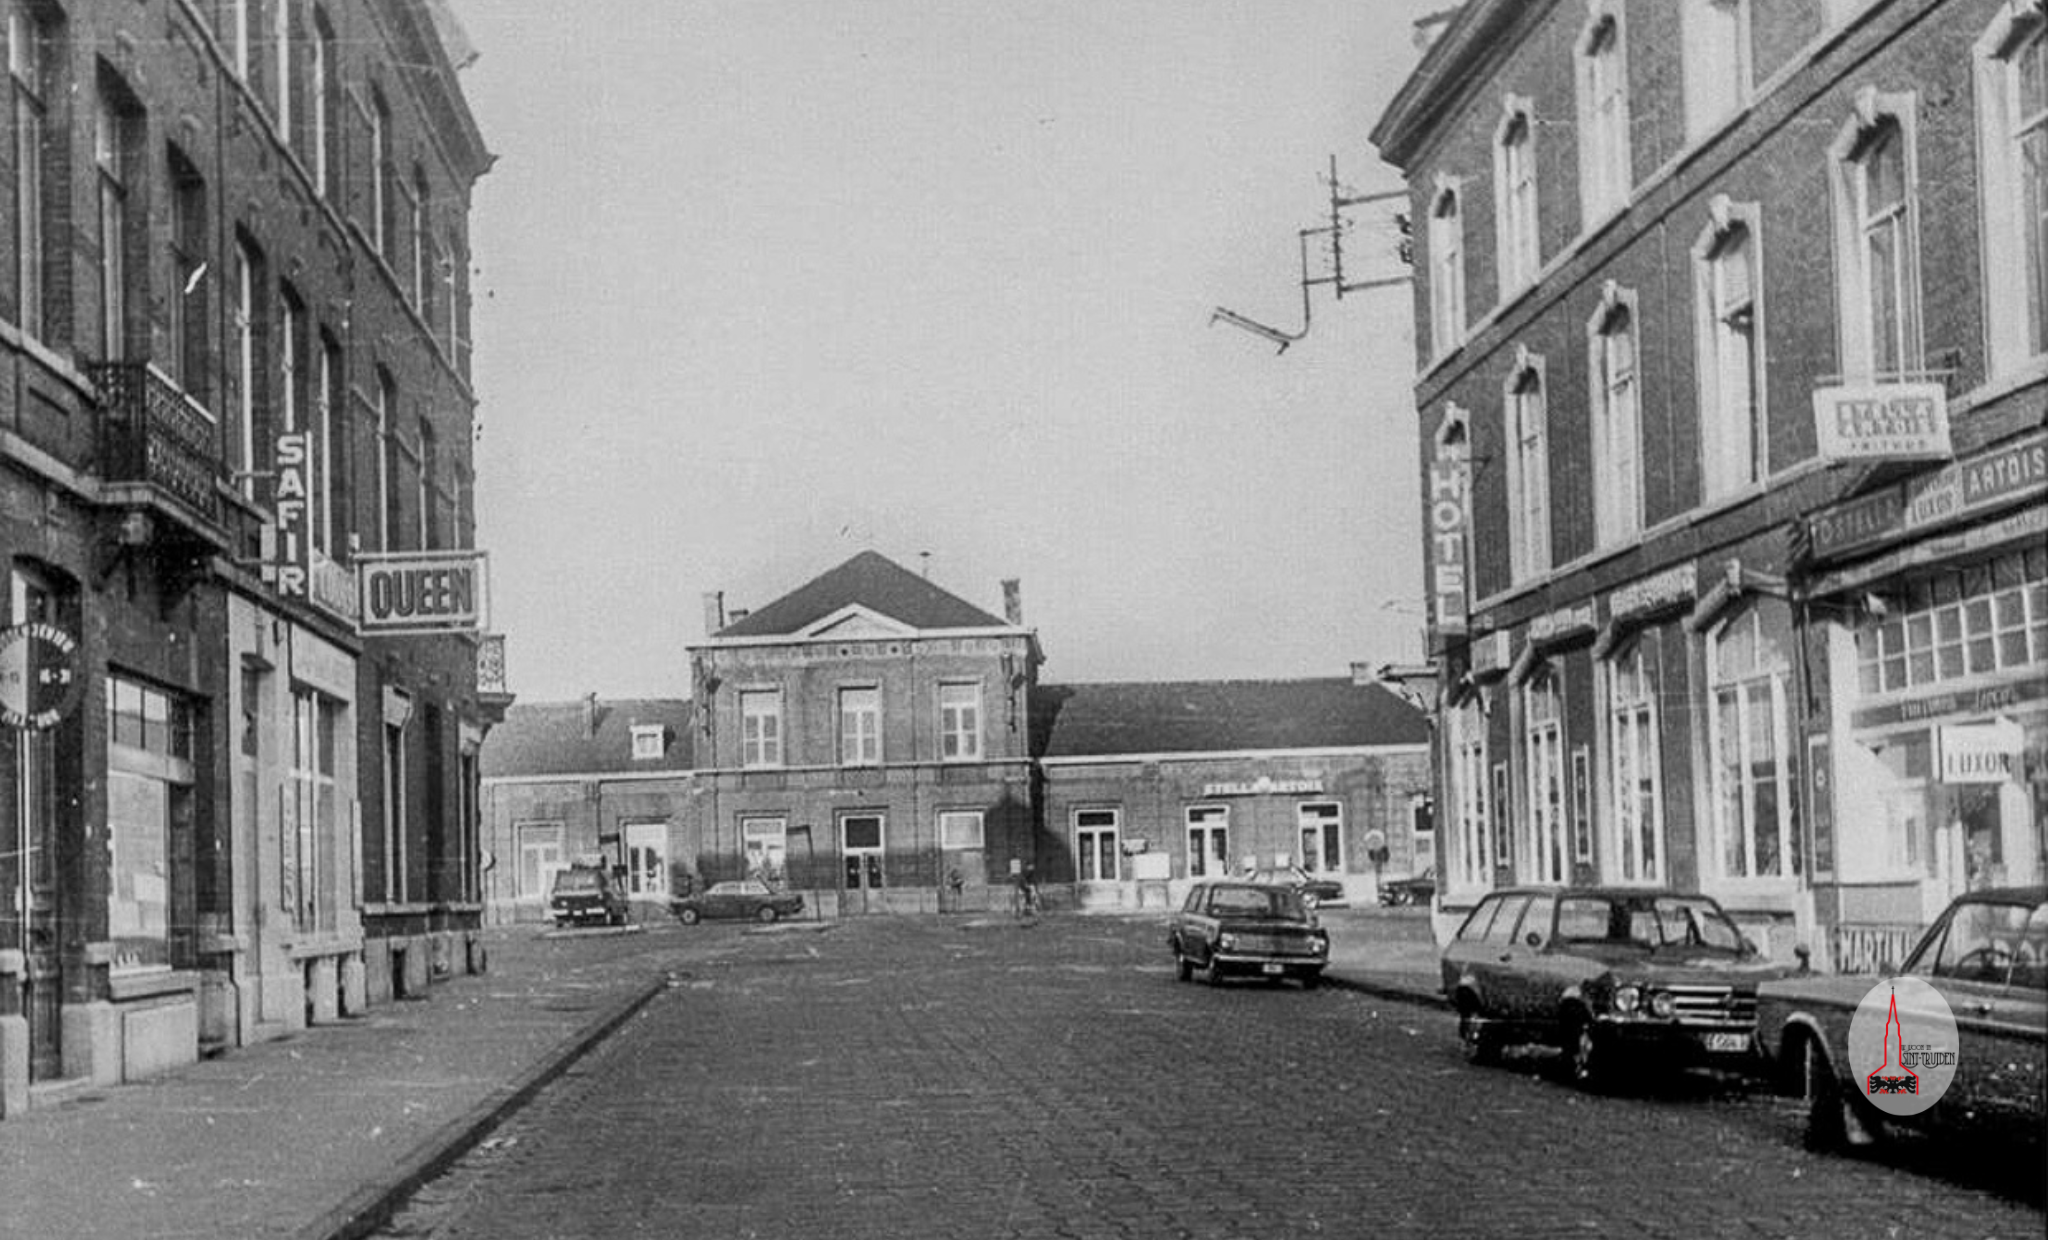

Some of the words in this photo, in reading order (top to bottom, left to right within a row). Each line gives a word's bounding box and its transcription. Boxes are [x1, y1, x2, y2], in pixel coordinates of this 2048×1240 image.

[277, 435, 305, 595] SAFIR
[1968, 447, 2046, 496] ARTOIS
[370, 568, 472, 619] QUEEN
[1430, 469, 1467, 625] HOTEL
